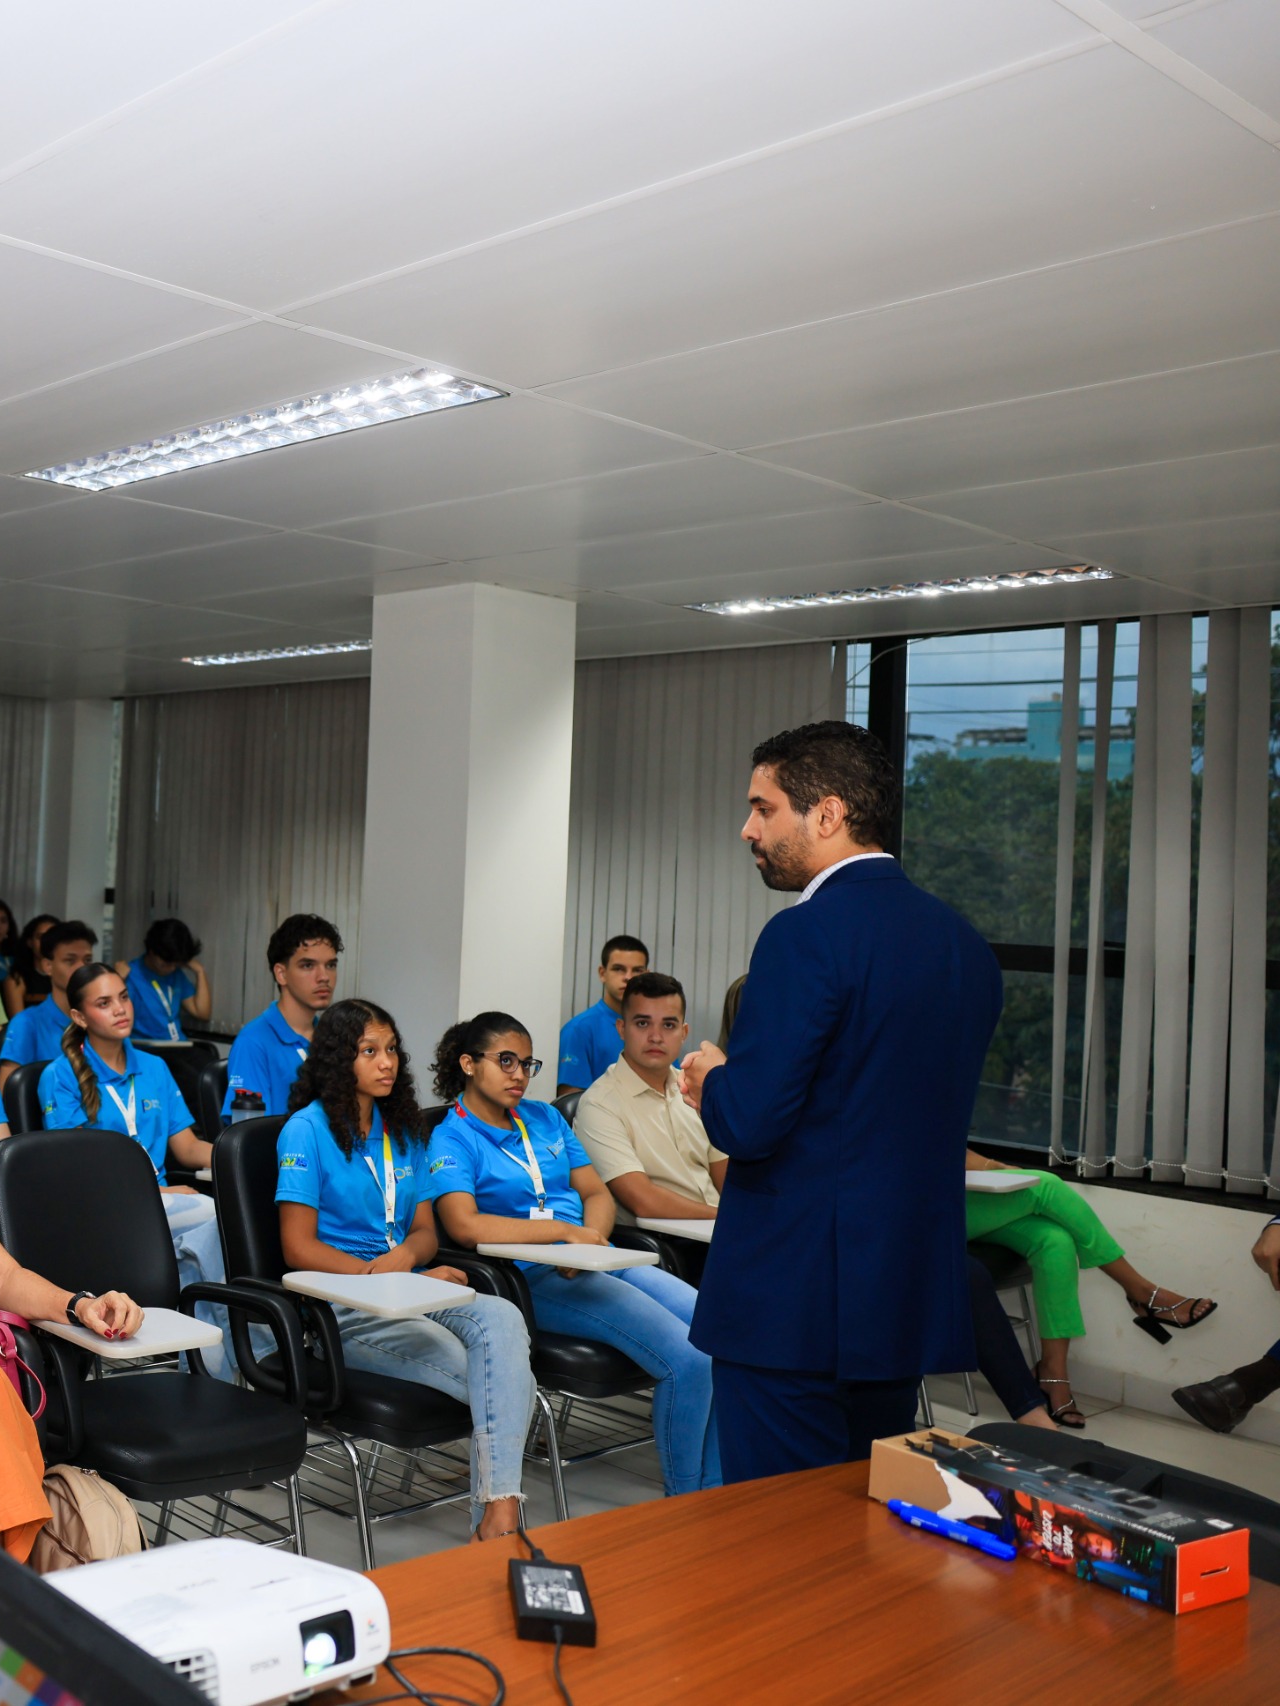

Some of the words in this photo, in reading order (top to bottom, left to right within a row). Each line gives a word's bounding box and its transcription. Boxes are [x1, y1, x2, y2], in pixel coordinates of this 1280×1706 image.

[1041, 1509, 1053, 1551] LISTEN
[1052, 1529, 1062, 1546] TO
[1062, 1524, 1074, 1558] DARE
